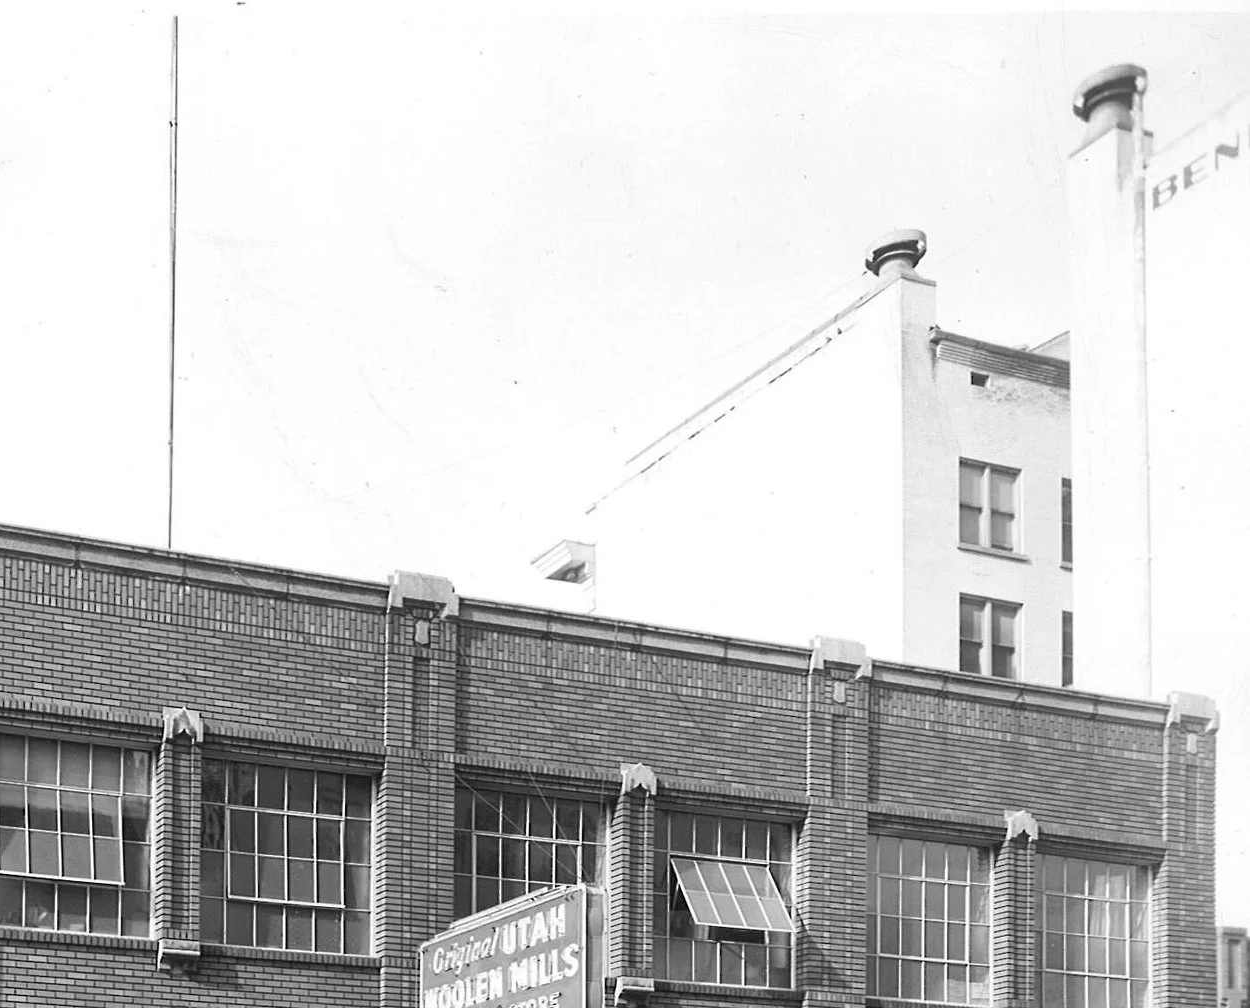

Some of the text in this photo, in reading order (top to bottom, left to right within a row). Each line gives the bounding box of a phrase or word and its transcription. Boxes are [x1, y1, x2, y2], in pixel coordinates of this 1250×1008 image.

[1152, 124, 1250, 210] BEN
[432, 903, 566, 975] Original UTAH
[508, 943, 579, 994] MILLS
